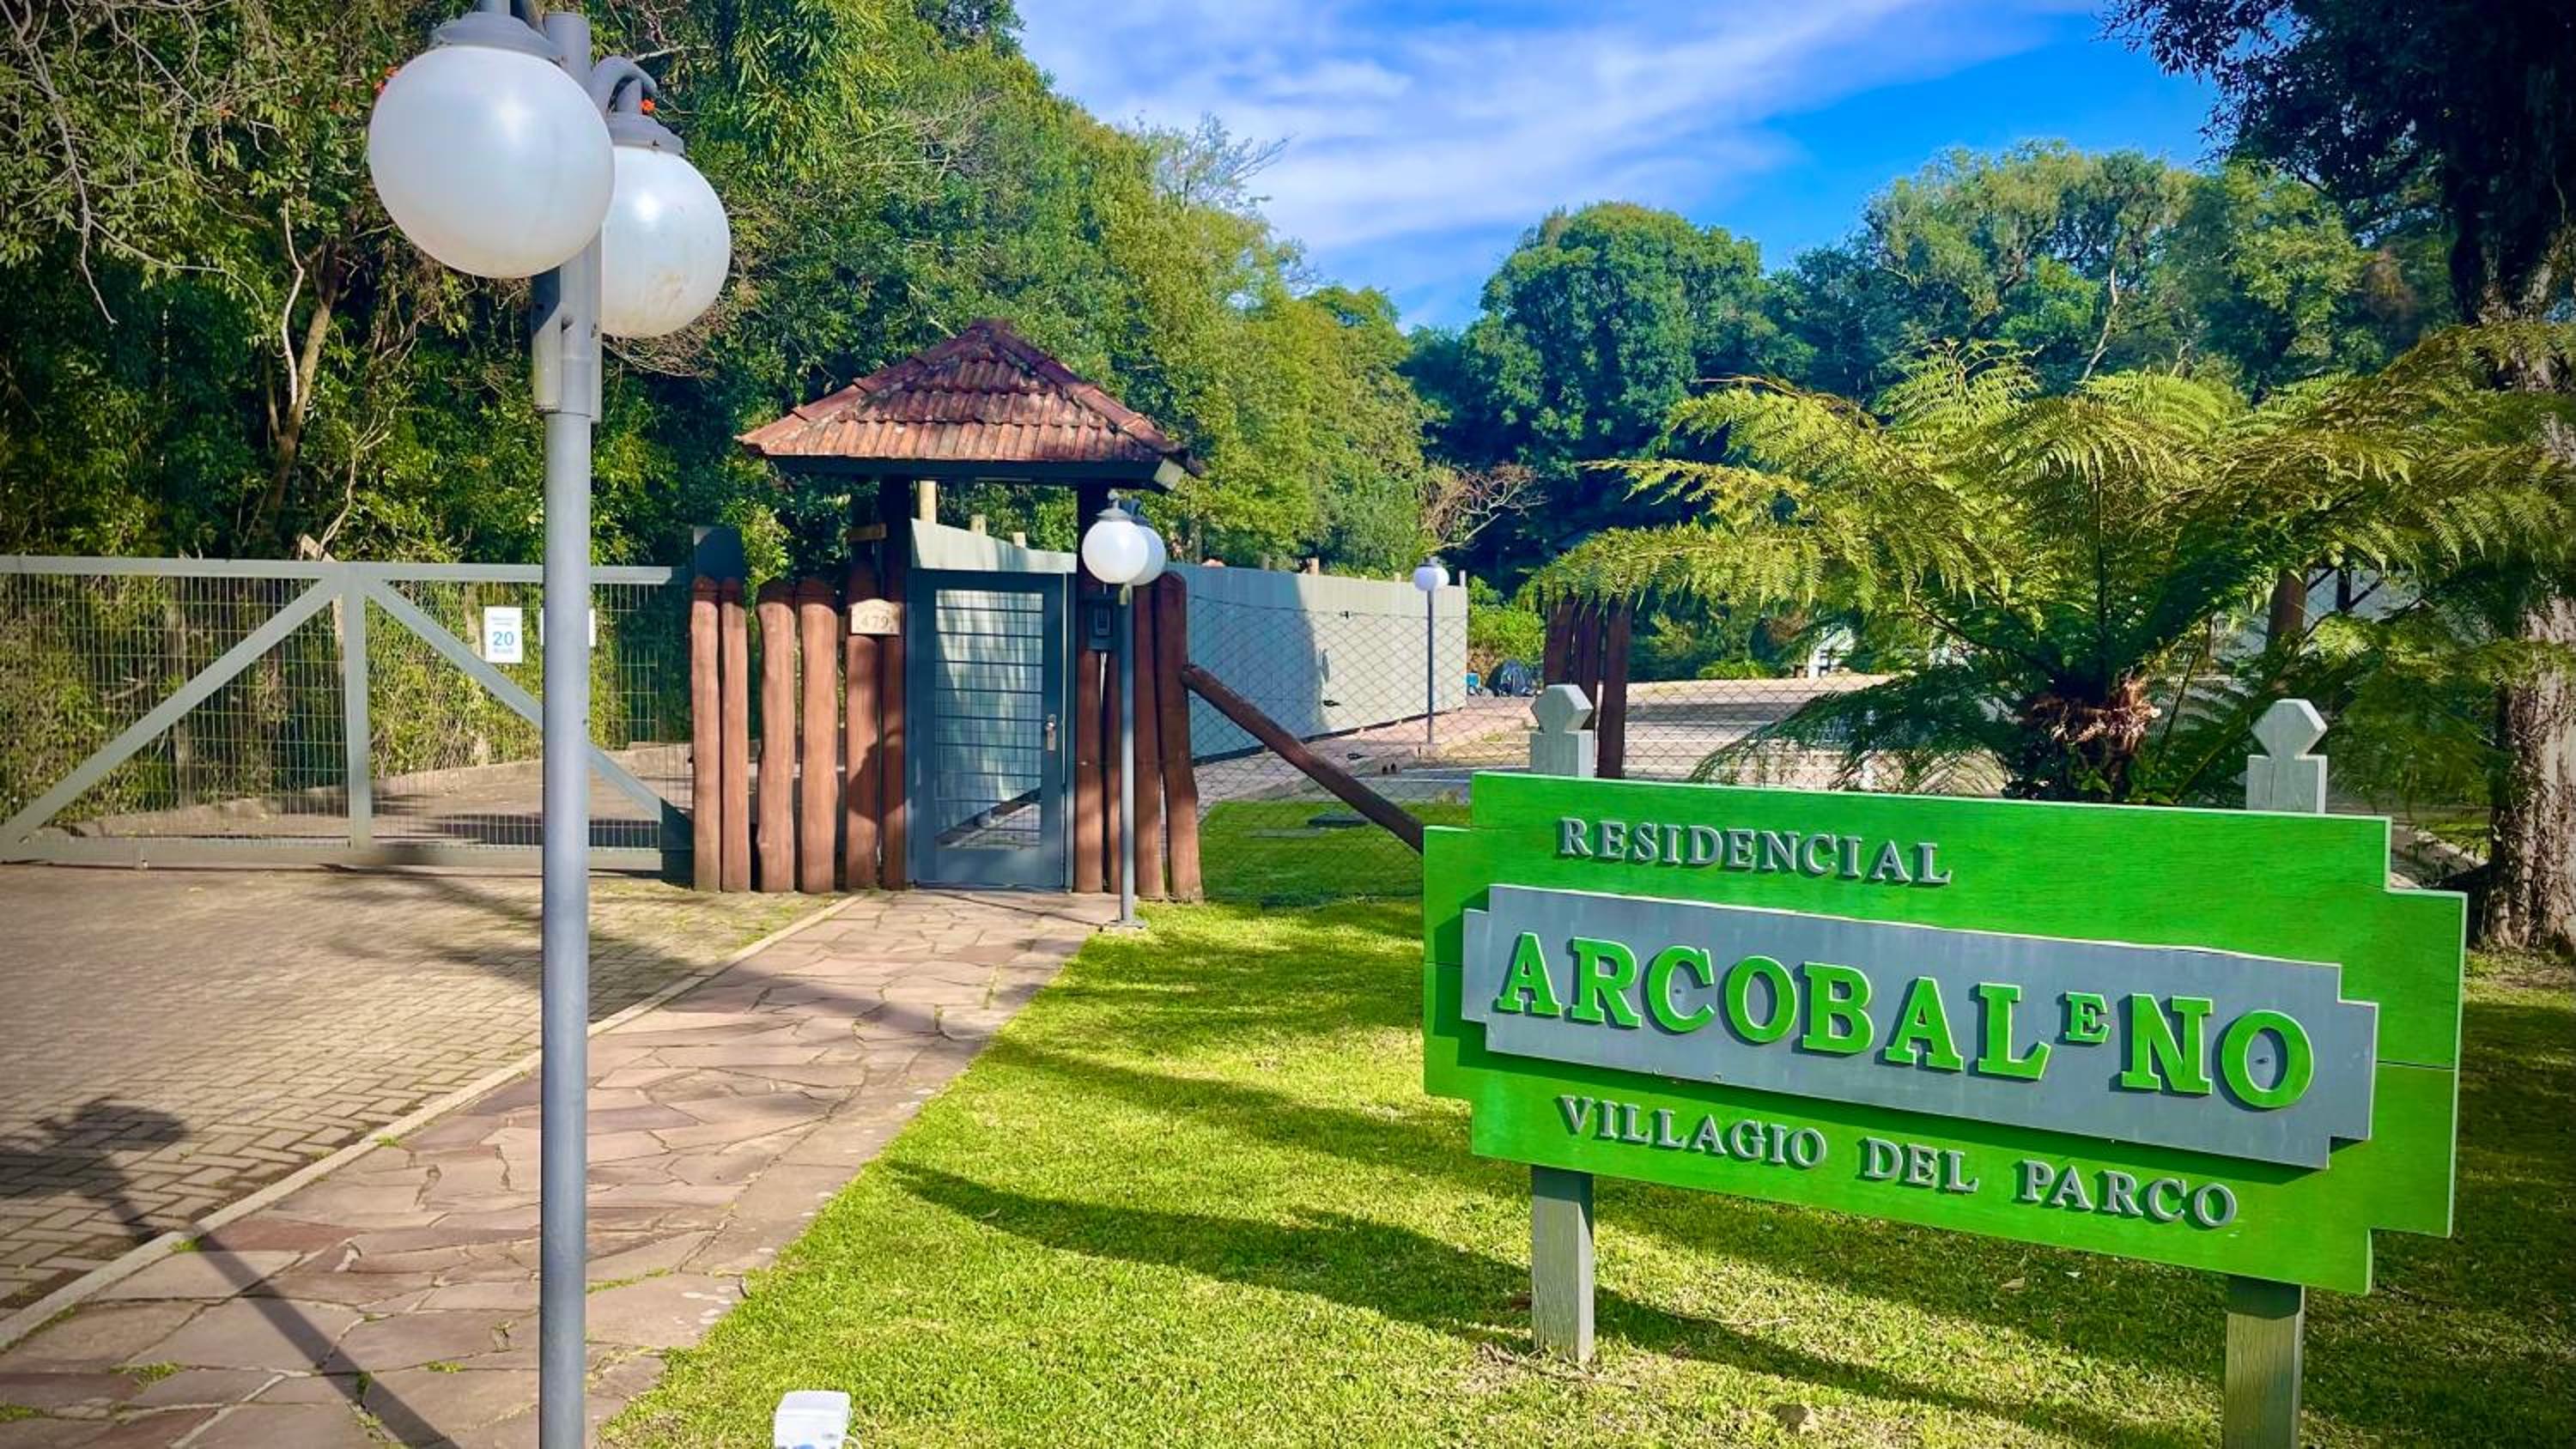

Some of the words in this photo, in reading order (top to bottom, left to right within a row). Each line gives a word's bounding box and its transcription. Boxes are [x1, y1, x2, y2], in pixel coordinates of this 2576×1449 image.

[493, 631, 514, 646] 20
[1560, 818, 1952, 884] RESIDENCIAL
[1495, 931, 2316, 1109] ARCOBALENO
[1559, 1094, 1829, 1170] VILLAGIO
[1865, 1138, 1979, 1194] DEL
[2020, 1160, 2238, 1229] PARCO
